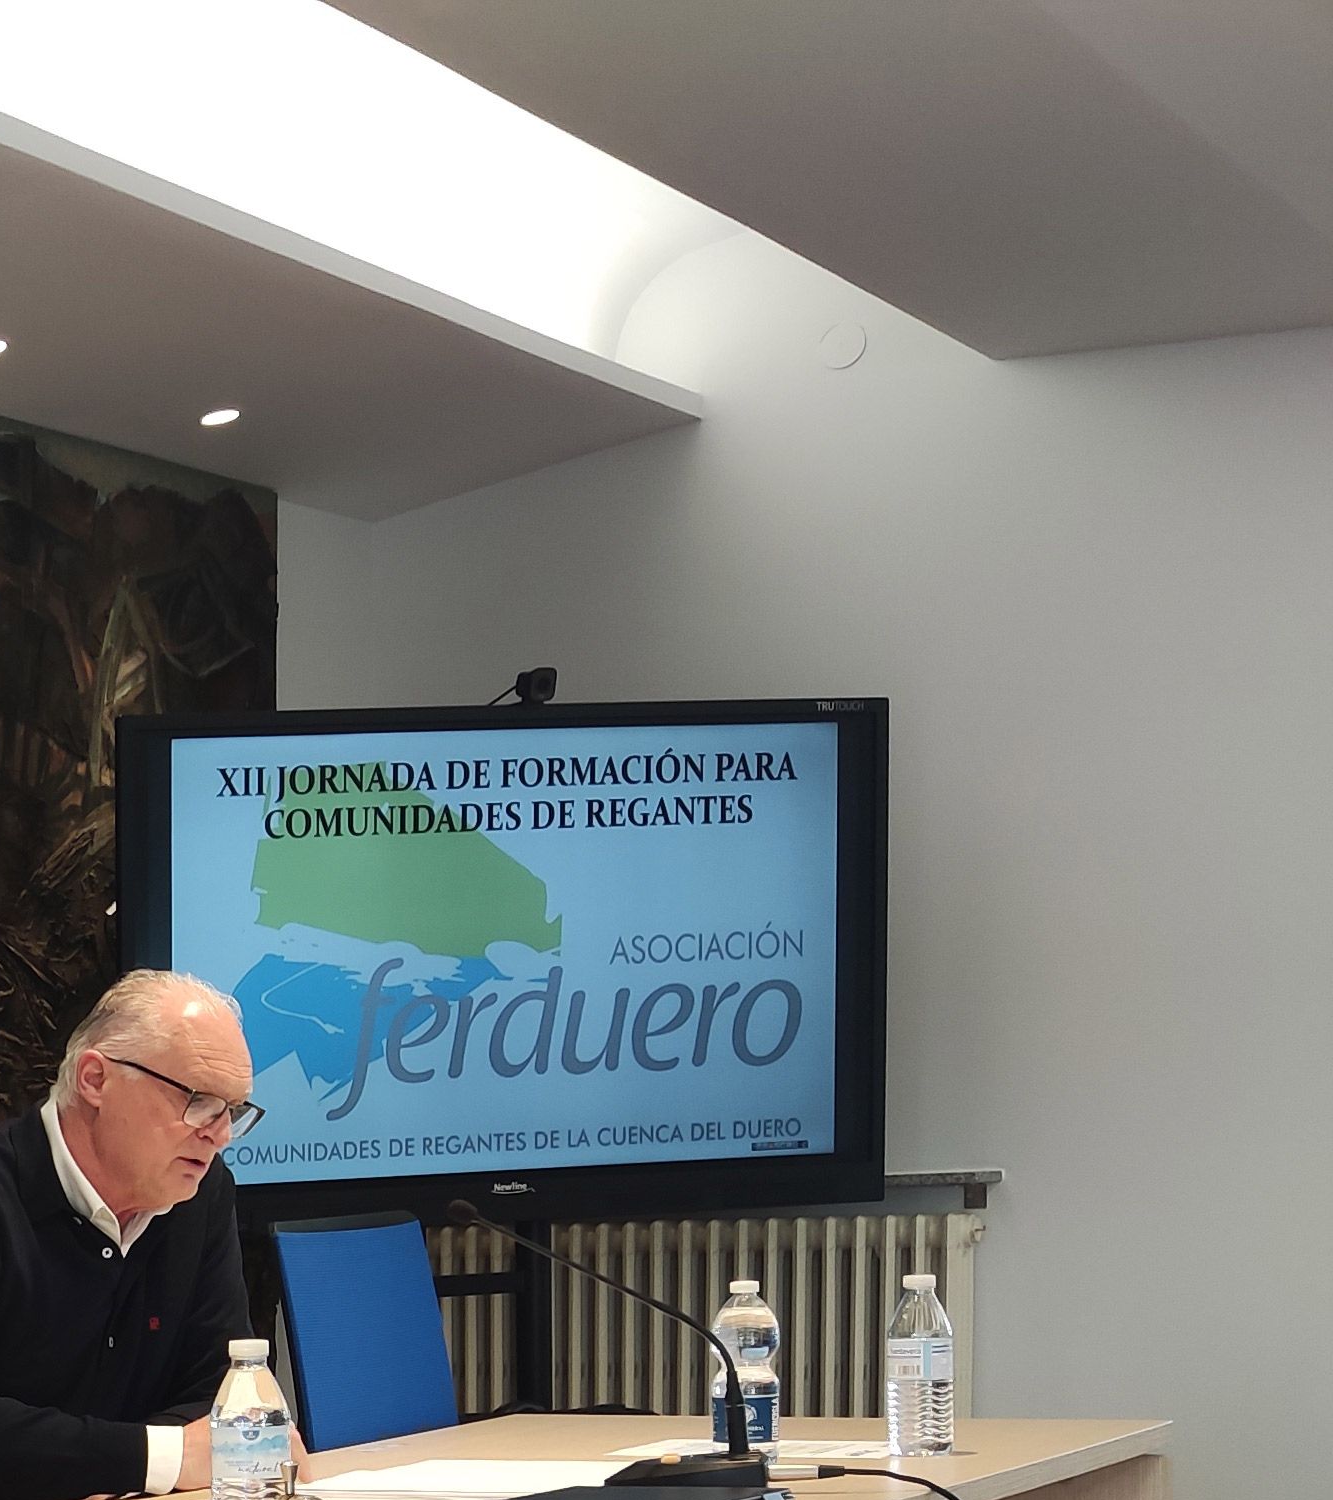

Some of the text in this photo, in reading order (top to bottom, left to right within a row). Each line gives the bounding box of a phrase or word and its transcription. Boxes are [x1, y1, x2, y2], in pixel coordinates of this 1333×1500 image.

[216, 747, 798, 802] XII JORNADA DE FORMACIÓN PARA
[264, 794, 753, 840] COMUNIDADES DE REGANTES
[609, 921, 804, 966] ASOCIACIÓN
[325, 957, 803, 1122] ferduero
[222, 1117, 802, 1167] COMUNIDADES DE REGANTES DE LA CUENCA DEL DUERO
